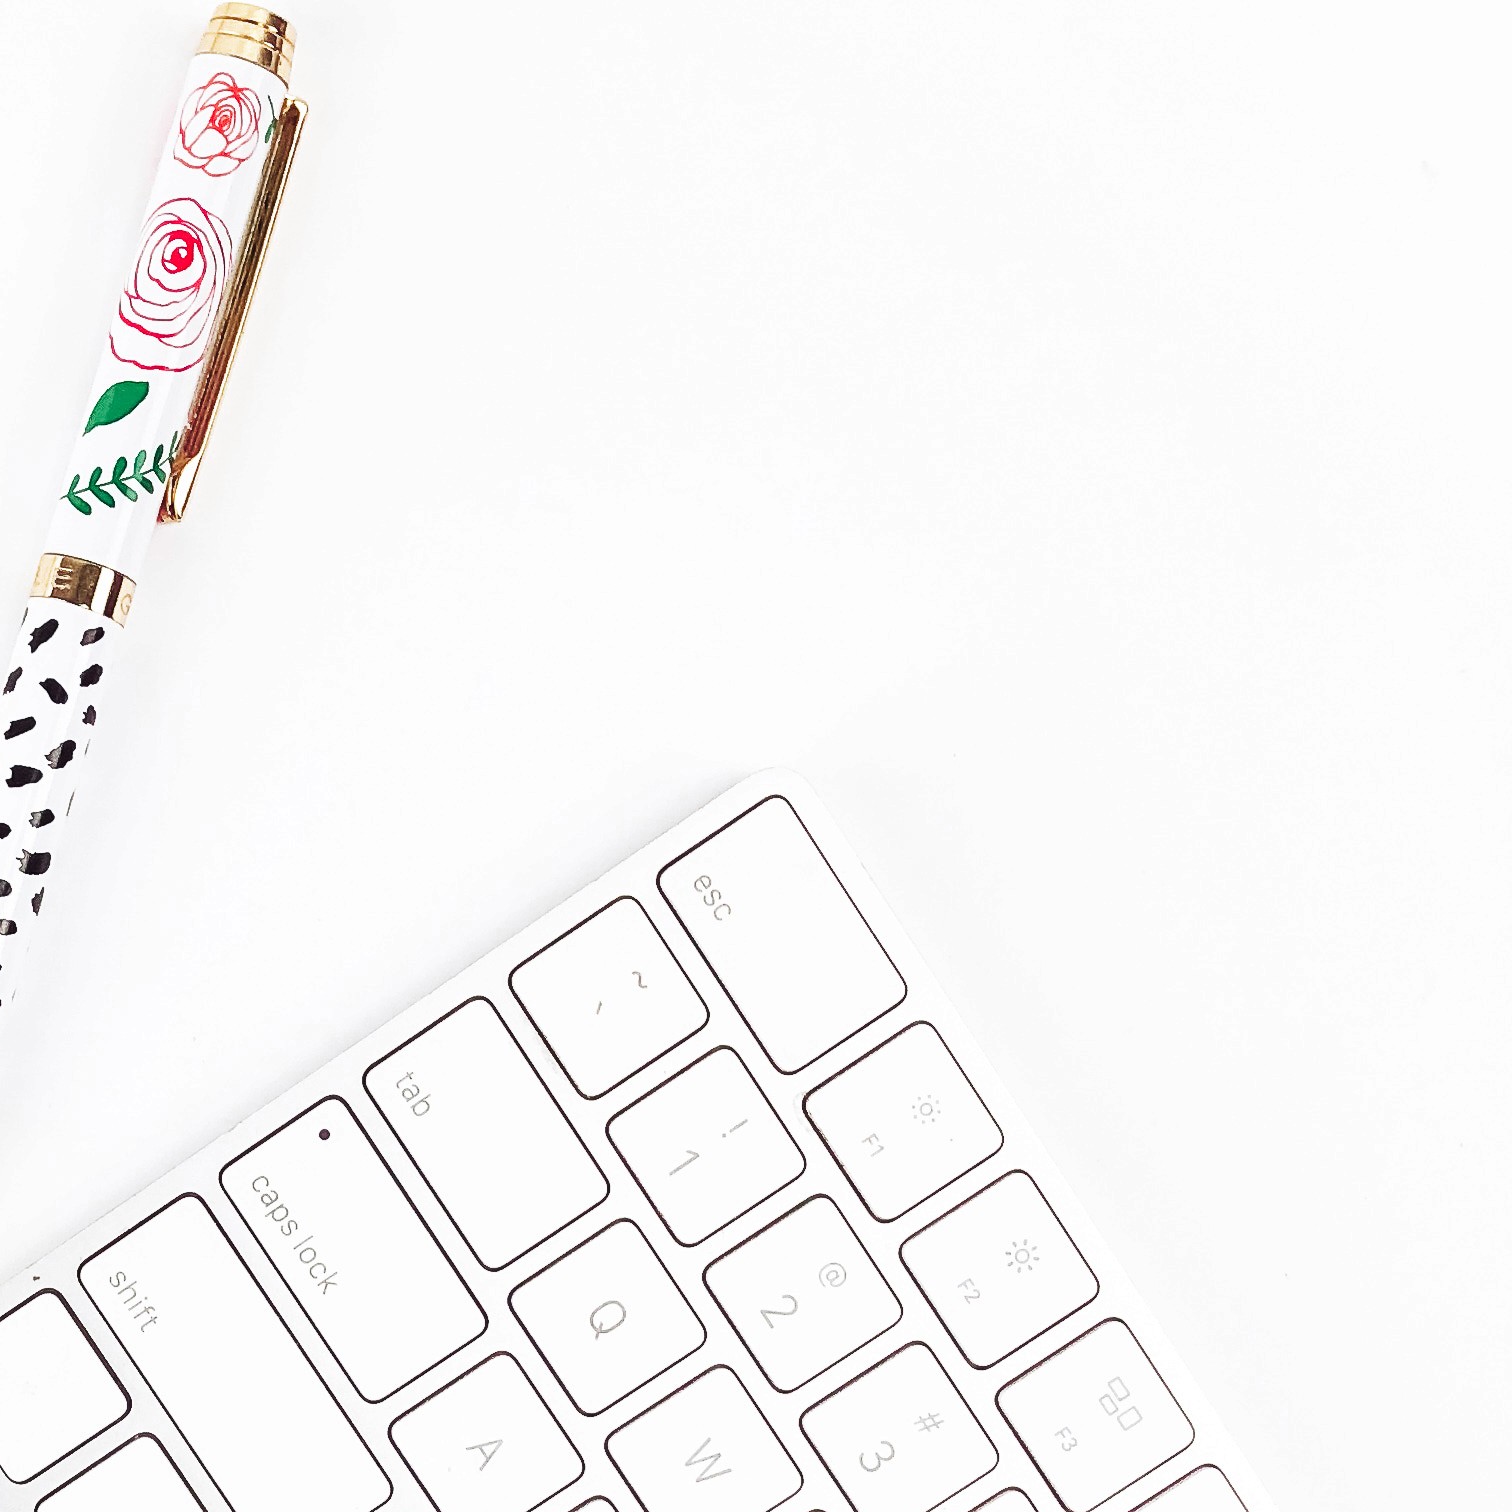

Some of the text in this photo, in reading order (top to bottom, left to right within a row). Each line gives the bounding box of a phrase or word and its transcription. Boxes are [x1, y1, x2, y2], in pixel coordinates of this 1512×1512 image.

[693, 874, 732, 922] esc
[395, 1071, 432, 1117] tab
[668, 1149, 701, 1177] 1
[861, 1132, 885, 1158] F1
[250, 1173, 339, 1296] caps lock
[108, 1269, 159, 1334] shift
[957, 1277, 981, 1305] F2
[589, 1299, 627, 1342] Q
[759, 1293, 799, 1330] 2
[465, 1438, 504, 1472] A
[858, 1440, 896, 1473] 3
[1054, 1426, 1078, 1452] F3
[684, 1436, 733, 1484] W
